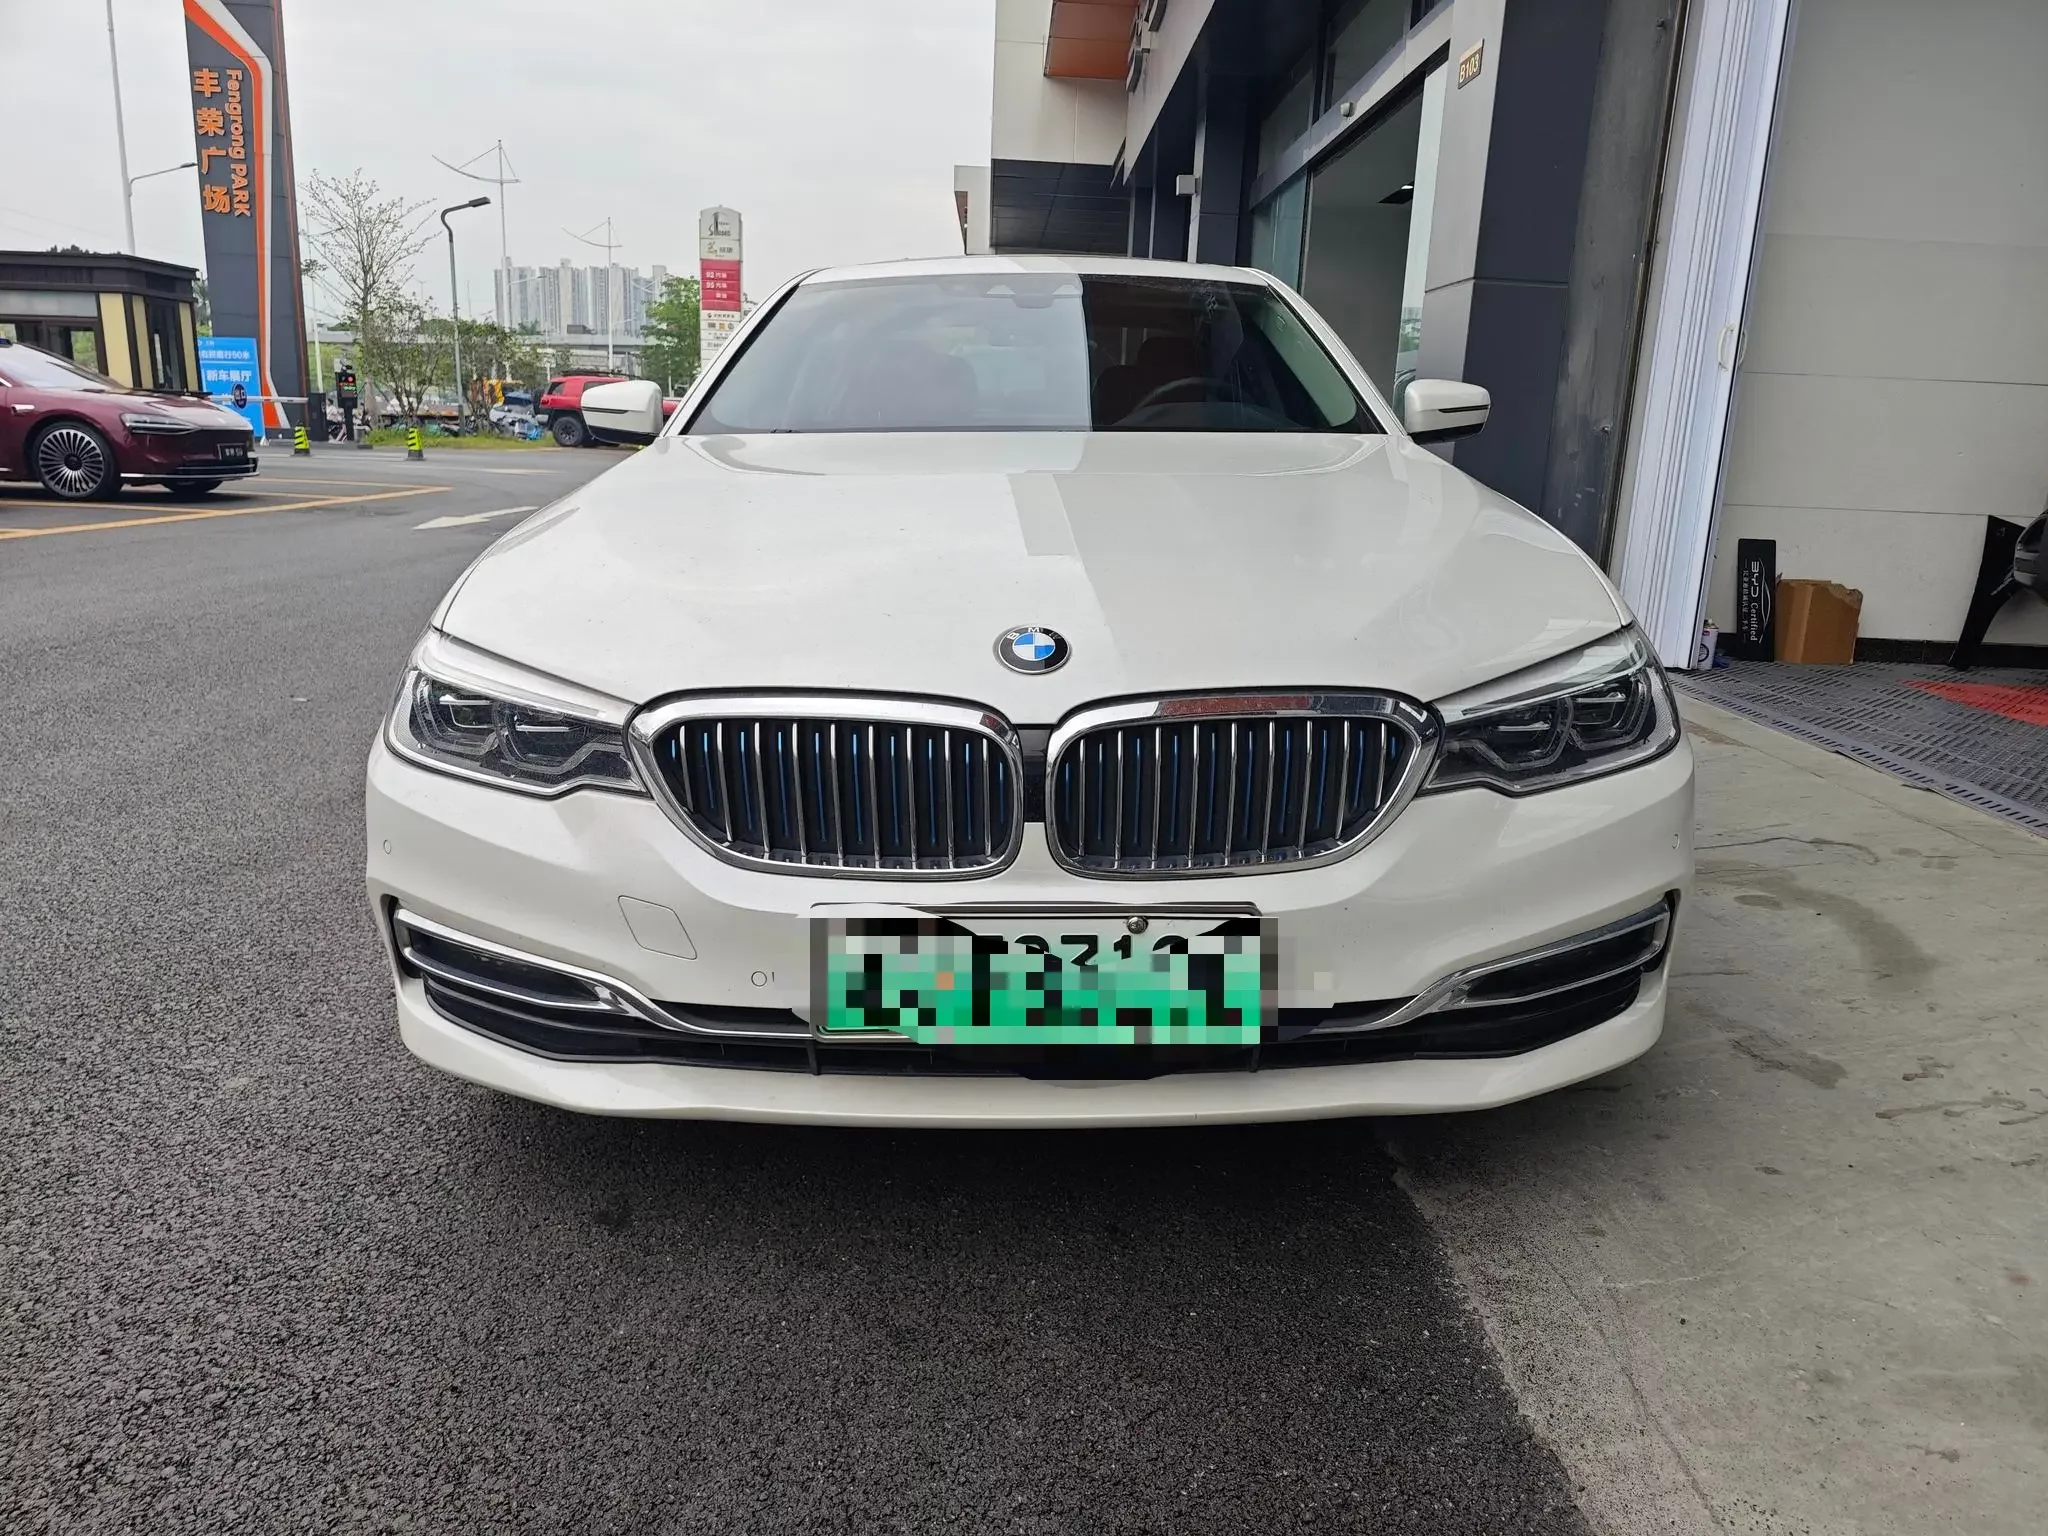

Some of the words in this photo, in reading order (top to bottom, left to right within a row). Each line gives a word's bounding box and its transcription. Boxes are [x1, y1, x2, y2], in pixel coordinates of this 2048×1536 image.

[1459, 53, 1480, 83] B103
[224, 69, 246, 160] Fengrong
[230, 164, 252, 216] PARK
[1751, 561, 1760, 598] BYD
[1007, 627, 1063, 640] BMW
[1750, 602, 1759, 641] Certified
